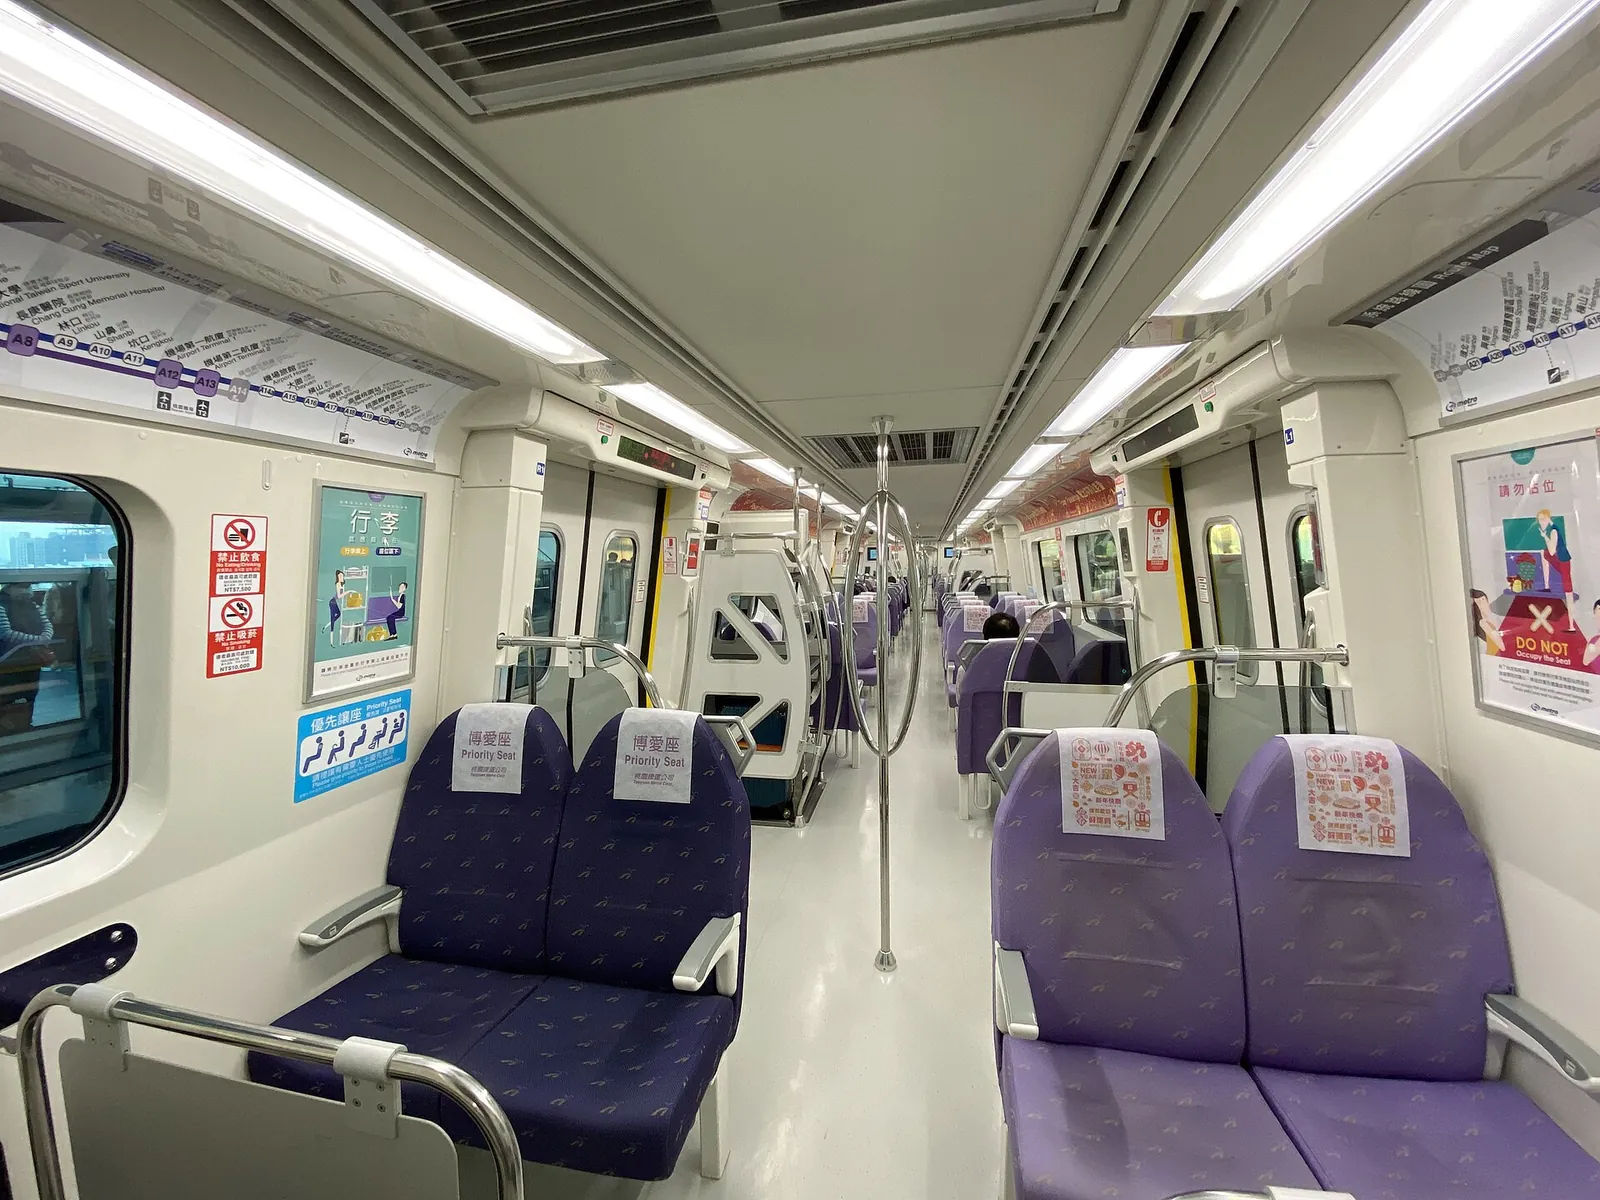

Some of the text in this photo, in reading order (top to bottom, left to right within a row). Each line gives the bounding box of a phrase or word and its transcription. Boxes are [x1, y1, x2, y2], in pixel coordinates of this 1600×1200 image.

[1432, 260, 1472, 280] Route
[1467, 245, 1500, 261] Map
[24, 286, 57, 300] Taiwan
[58, 279, 84, 290] Sport
[85, 272, 131, 283] University
[32, 310, 62, 325] Chang
[62, 303, 87, 314] Gung
[87, 291, 128, 306] Memorial
[129, 285, 166, 297] Hospital
[57, 316, 82, 332] 林口
[72, 321, 100, 335] Linkou
[1560, 325, 1574, 336] A17
[12, 333, 34, 347] A8
[57, 337, 74, 347] A9
[107, 328, 135, 344] Shanbi
[1535, 334, 1549, 344] A18
[140, 336, 174, 352] Kengkou
[177, 347, 200, 361] Airport
[200, 336, 231, 352] Terminal
[1511, 343, 1525, 354] A19
[90, 345, 111, 357] A10
[1490, 351, 1502, 361] A20
[125, 353, 142, 364] A11
[214, 357, 237, 370] Airport
[237, 347, 267, 362] Terminal
[1469, 359, 1481, 368] A21
[158, 367, 179, 380] A12
[196, 377, 216, 389] A13
[229, 385, 248, 395] A14
[283, 392, 296, 401] A15
[304, 398, 318, 406] A16
[198, 409, 207, 417] T2
[1285, 431, 1293, 442] L1
[217, 551, 260, 563] 禁止飲食
[1515, 636, 1569, 657] DO NOT
[1515, 649, 1571, 666] Occupy the Seat
[311, 696, 402, 733] 優先讓座 Priority Seat
[1540, 706, 1559, 714] metro
[469, 730, 512, 747] 博愛座
[633, 735, 681, 753] 博愛座
[461, 749, 516, 761] Priority Seat
[625, 754, 685, 768] Priority Seat
[1072, 777, 1080, 792] 大吉
